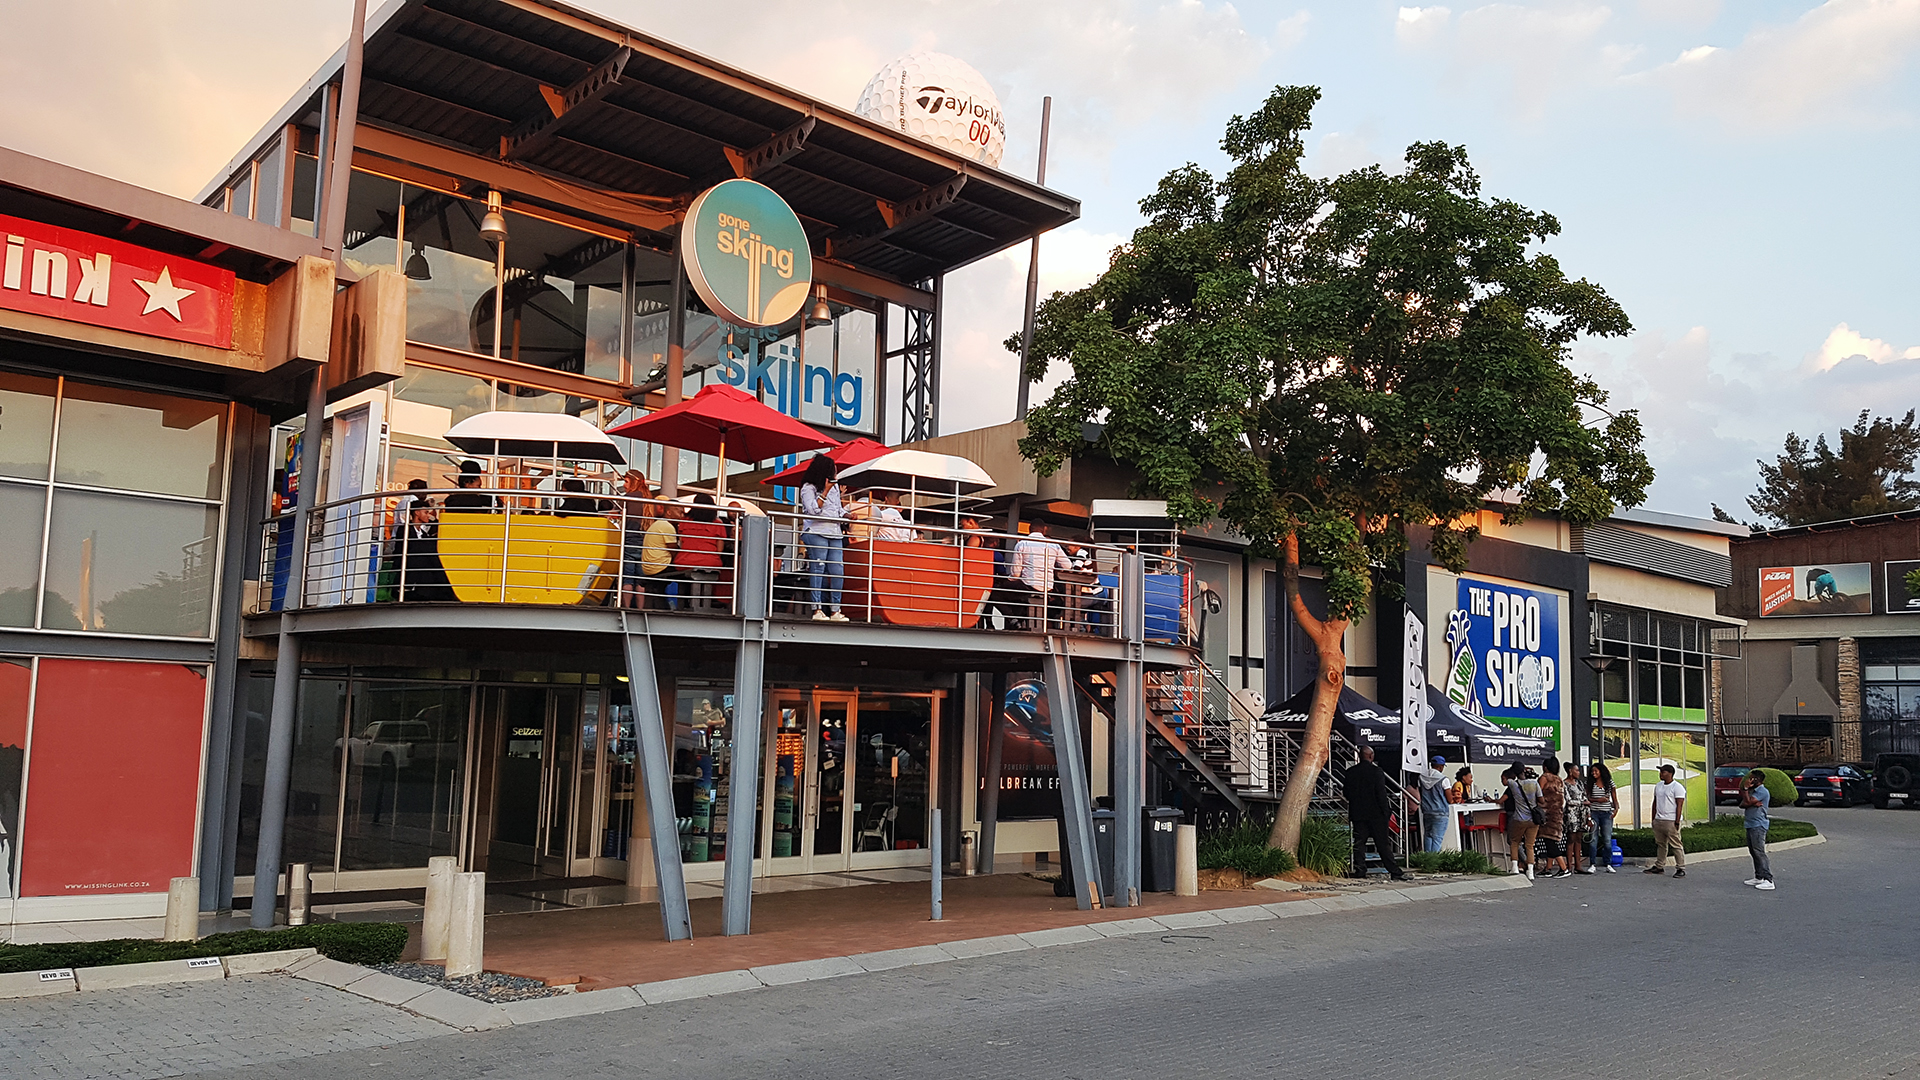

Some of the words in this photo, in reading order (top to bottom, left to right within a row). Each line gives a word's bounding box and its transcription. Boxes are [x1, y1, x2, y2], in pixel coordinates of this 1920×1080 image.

[969, 119, 990, 146] 00
[717, 212, 750, 232] gone
[716, 336, 863, 427] skiing
[1763, 571, 1791, 581] KTM
[1764, 590, 1792, 612] AUSTRIA
[1468, 587, 1491, 617] THE
[1493, 591, 1540, 652] PRO
[1486, 649, 1555, 710] SHOP
[980, 777, 1043, 789] JLBREAK
[64, 881, 150, 889] WWW.MISSINGLINK.CO.ZA
